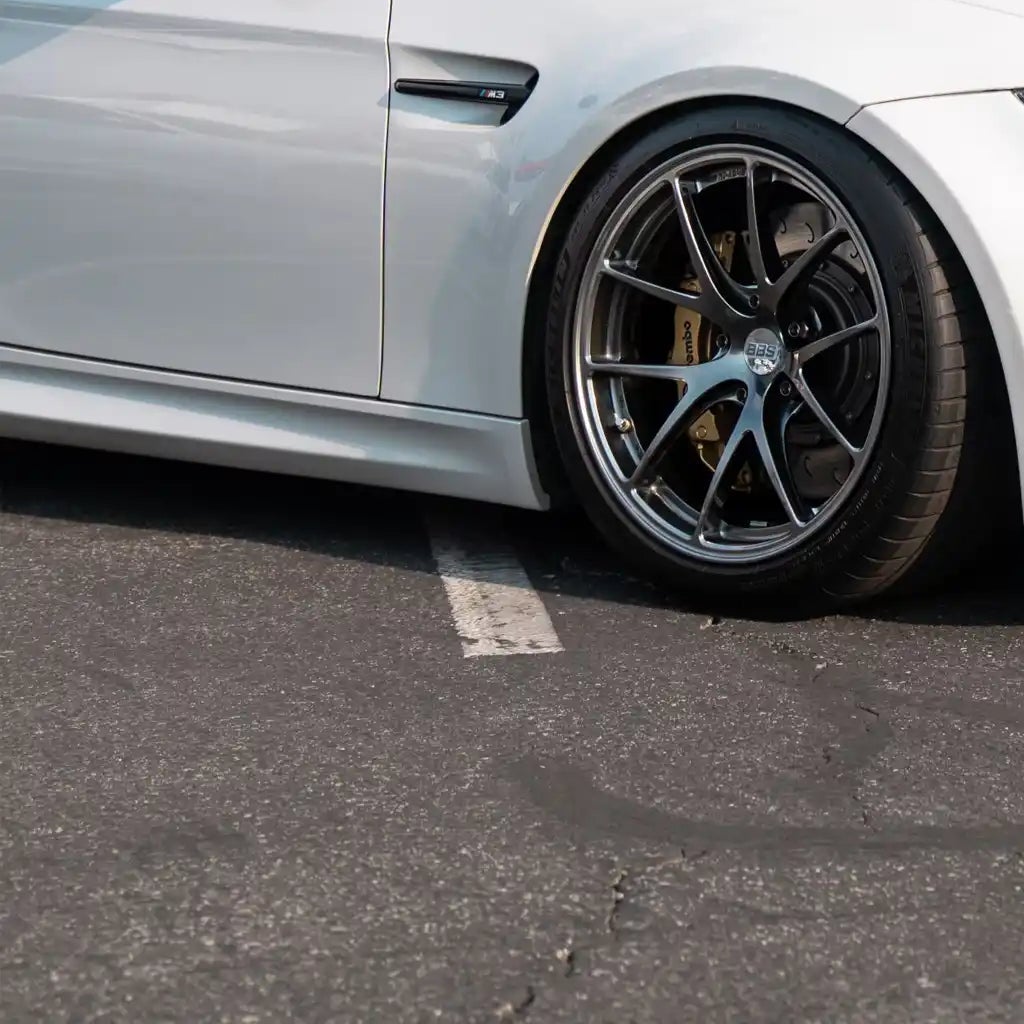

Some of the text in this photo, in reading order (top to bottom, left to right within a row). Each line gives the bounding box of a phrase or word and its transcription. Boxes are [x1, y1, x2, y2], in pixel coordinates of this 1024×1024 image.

[487, 89, 505, 99] M3
[682, 320, 694, 365] embo
[746, 342, 777, 358] BBS
